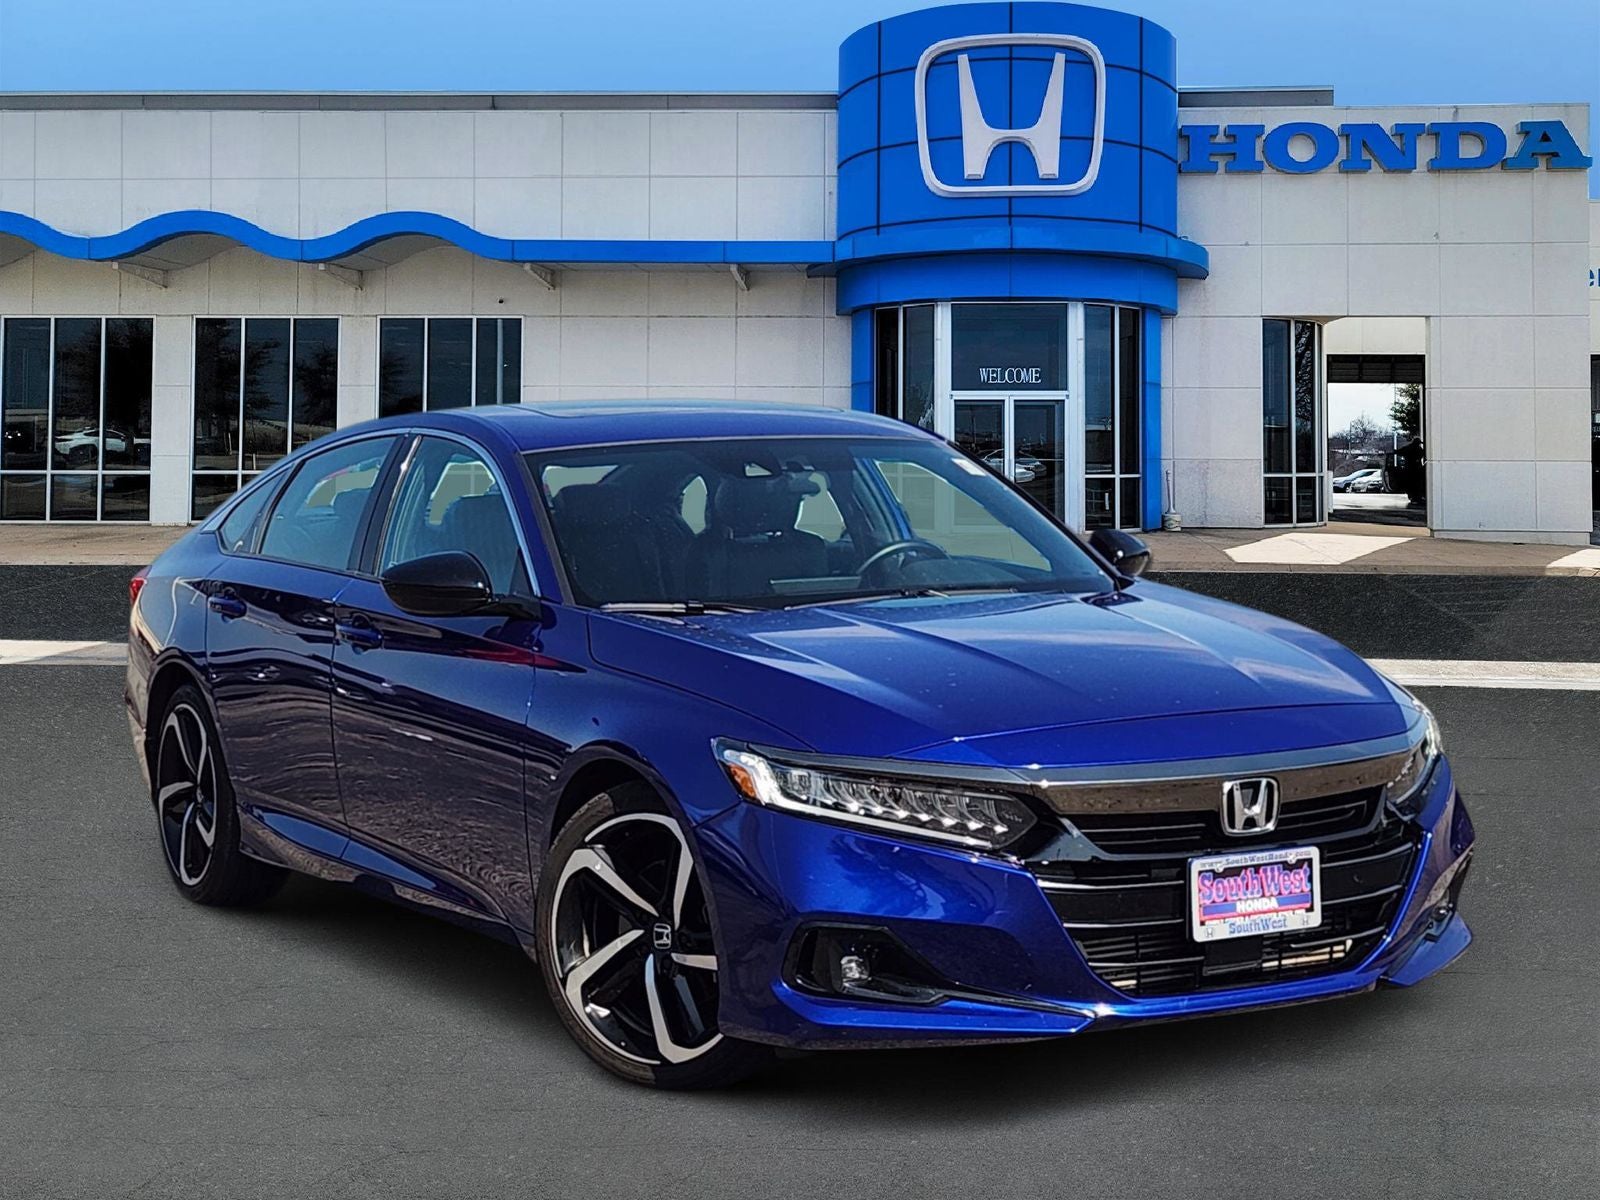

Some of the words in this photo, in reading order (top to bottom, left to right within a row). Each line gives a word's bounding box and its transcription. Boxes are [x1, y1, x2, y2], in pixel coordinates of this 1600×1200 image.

[1179, 121, 1593, 174] HONDA
[979, 367, 1041, 384] WELCOME
[1199, 861, 1311, 905] SouthWest
[1236, 896, 1279, 913] HONDA
[1229, 916, 1287, 934] SouthWest
